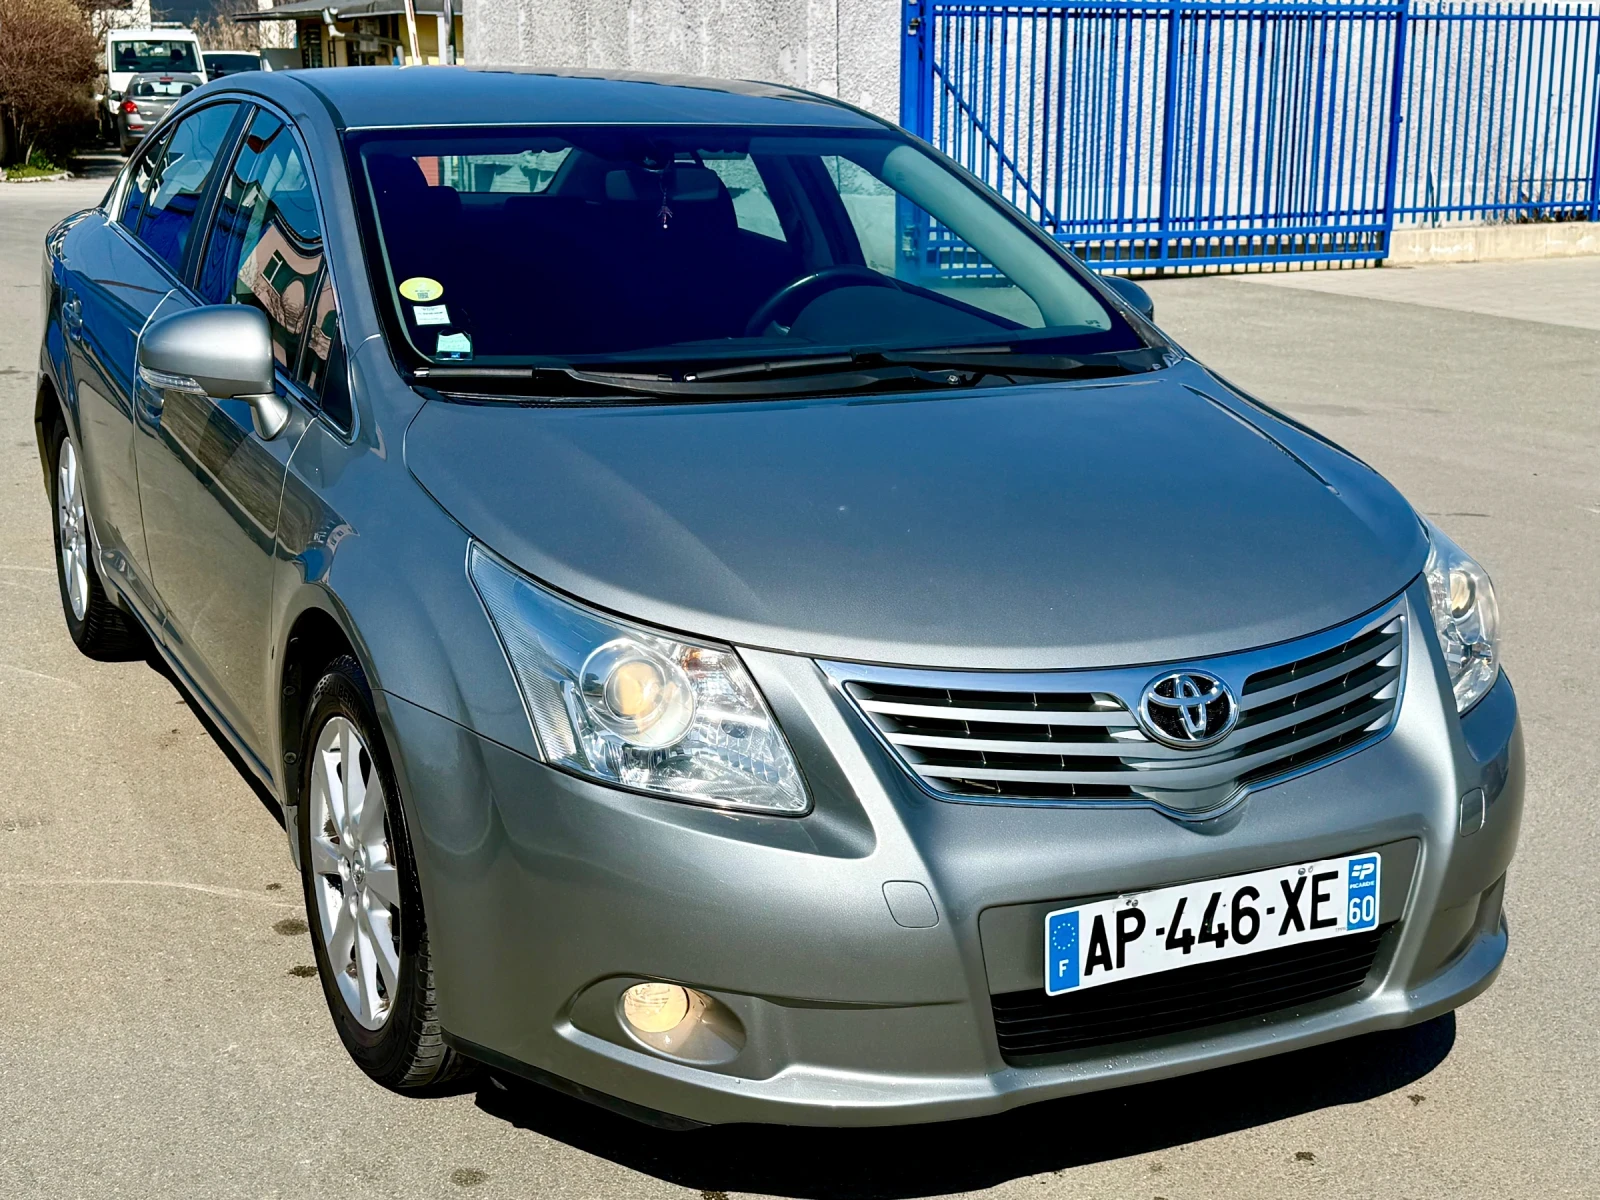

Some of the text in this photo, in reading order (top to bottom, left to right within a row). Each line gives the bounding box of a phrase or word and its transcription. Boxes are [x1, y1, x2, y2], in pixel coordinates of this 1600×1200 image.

[1084, 870, 1339, 976] AP-446-XE
[1348, 894, 1375, 924] 60
[1059, 959, 1070, 978] F
